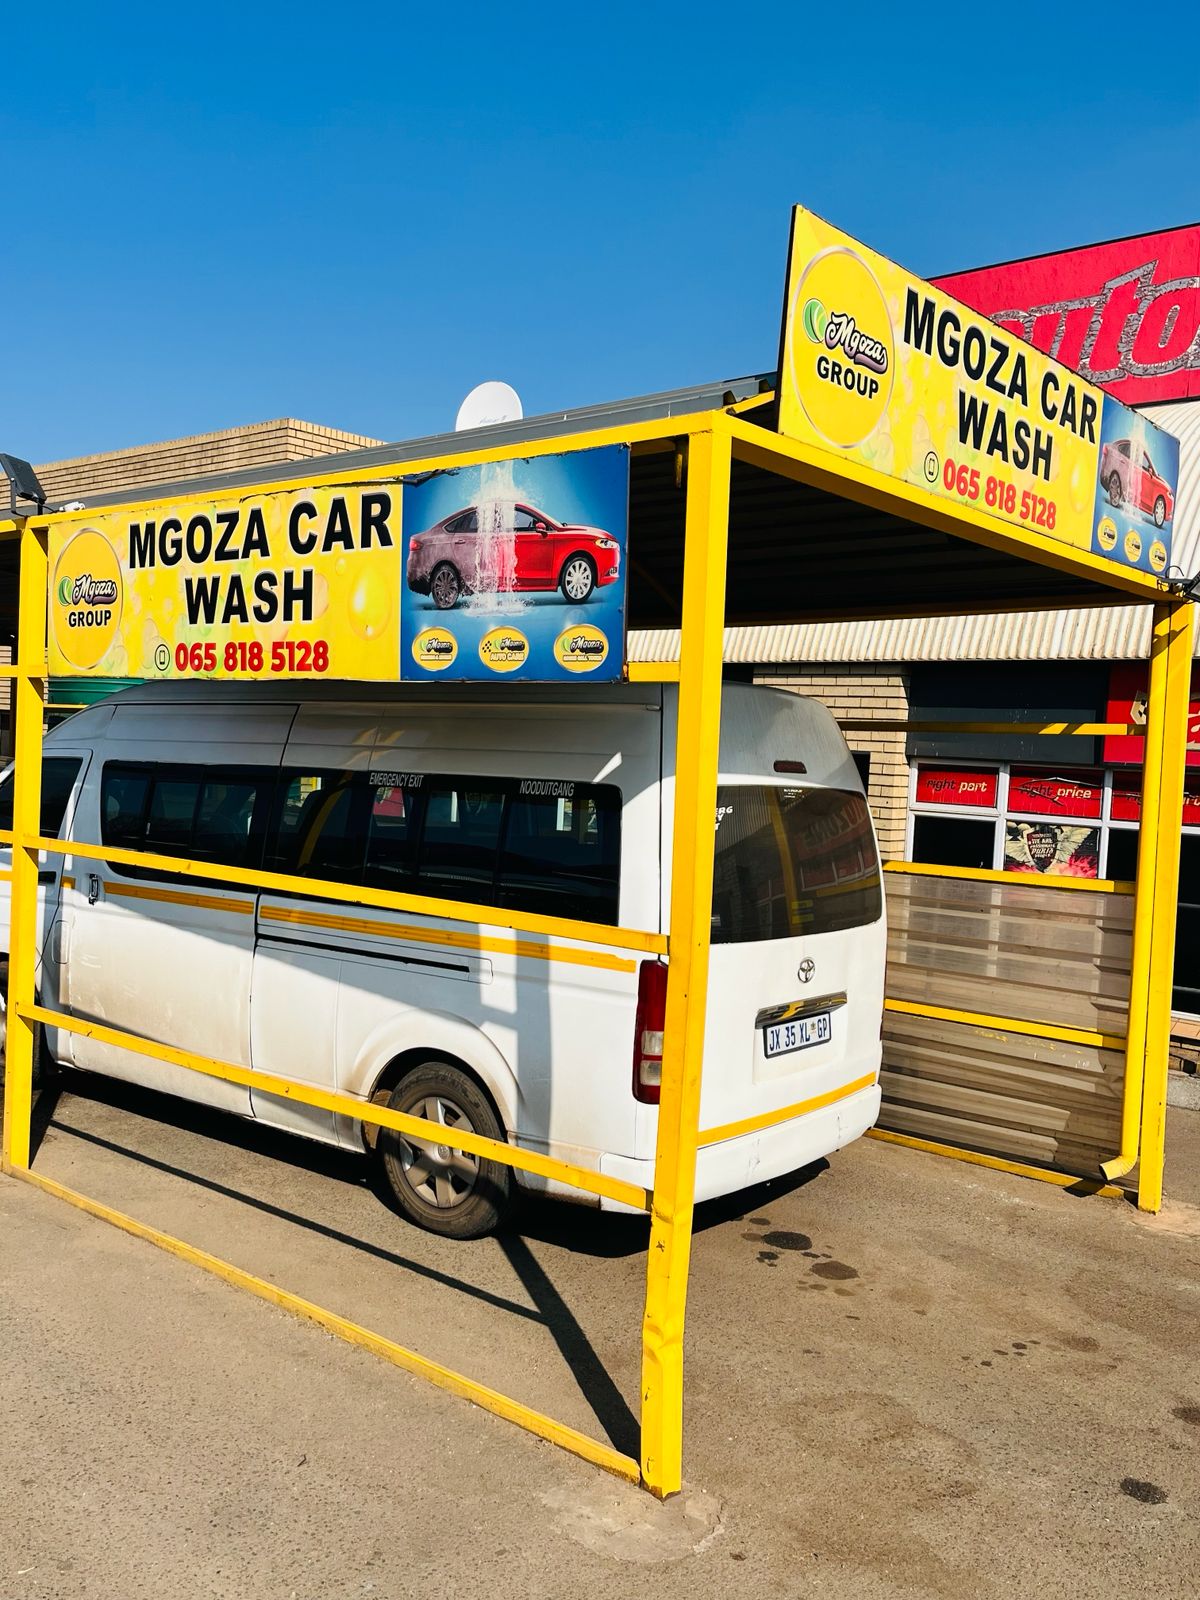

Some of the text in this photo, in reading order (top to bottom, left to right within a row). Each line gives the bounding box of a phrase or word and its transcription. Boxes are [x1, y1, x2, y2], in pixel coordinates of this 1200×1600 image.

[825, 312, 888, 374] Mgoza
[817, 356, 878, 399] GROUP
[903, 286, 1097, 444] MGOZA CAR
[959, 389, 1053, 482] WASH
[943, 458, 1057, 530] 065 818 5128
[129, 491, 393, 569] MGOZA CAR
[72, 574, 118, 606] Mgoza
[185, 569, 313, 625] WASH
[68, 610, 111, 627] GROUP
[175, 640, 329, 672] 065 818 5128
[369, 772, 424, 788] EMERGENCY EXIT
[519, 780, 575, 797] NOODUITGANG
[926, 778, 988, 793] right part
[1054, 785, 1092, 801] price
[769, 1017, 828, 1051] JX 35 XL GP
